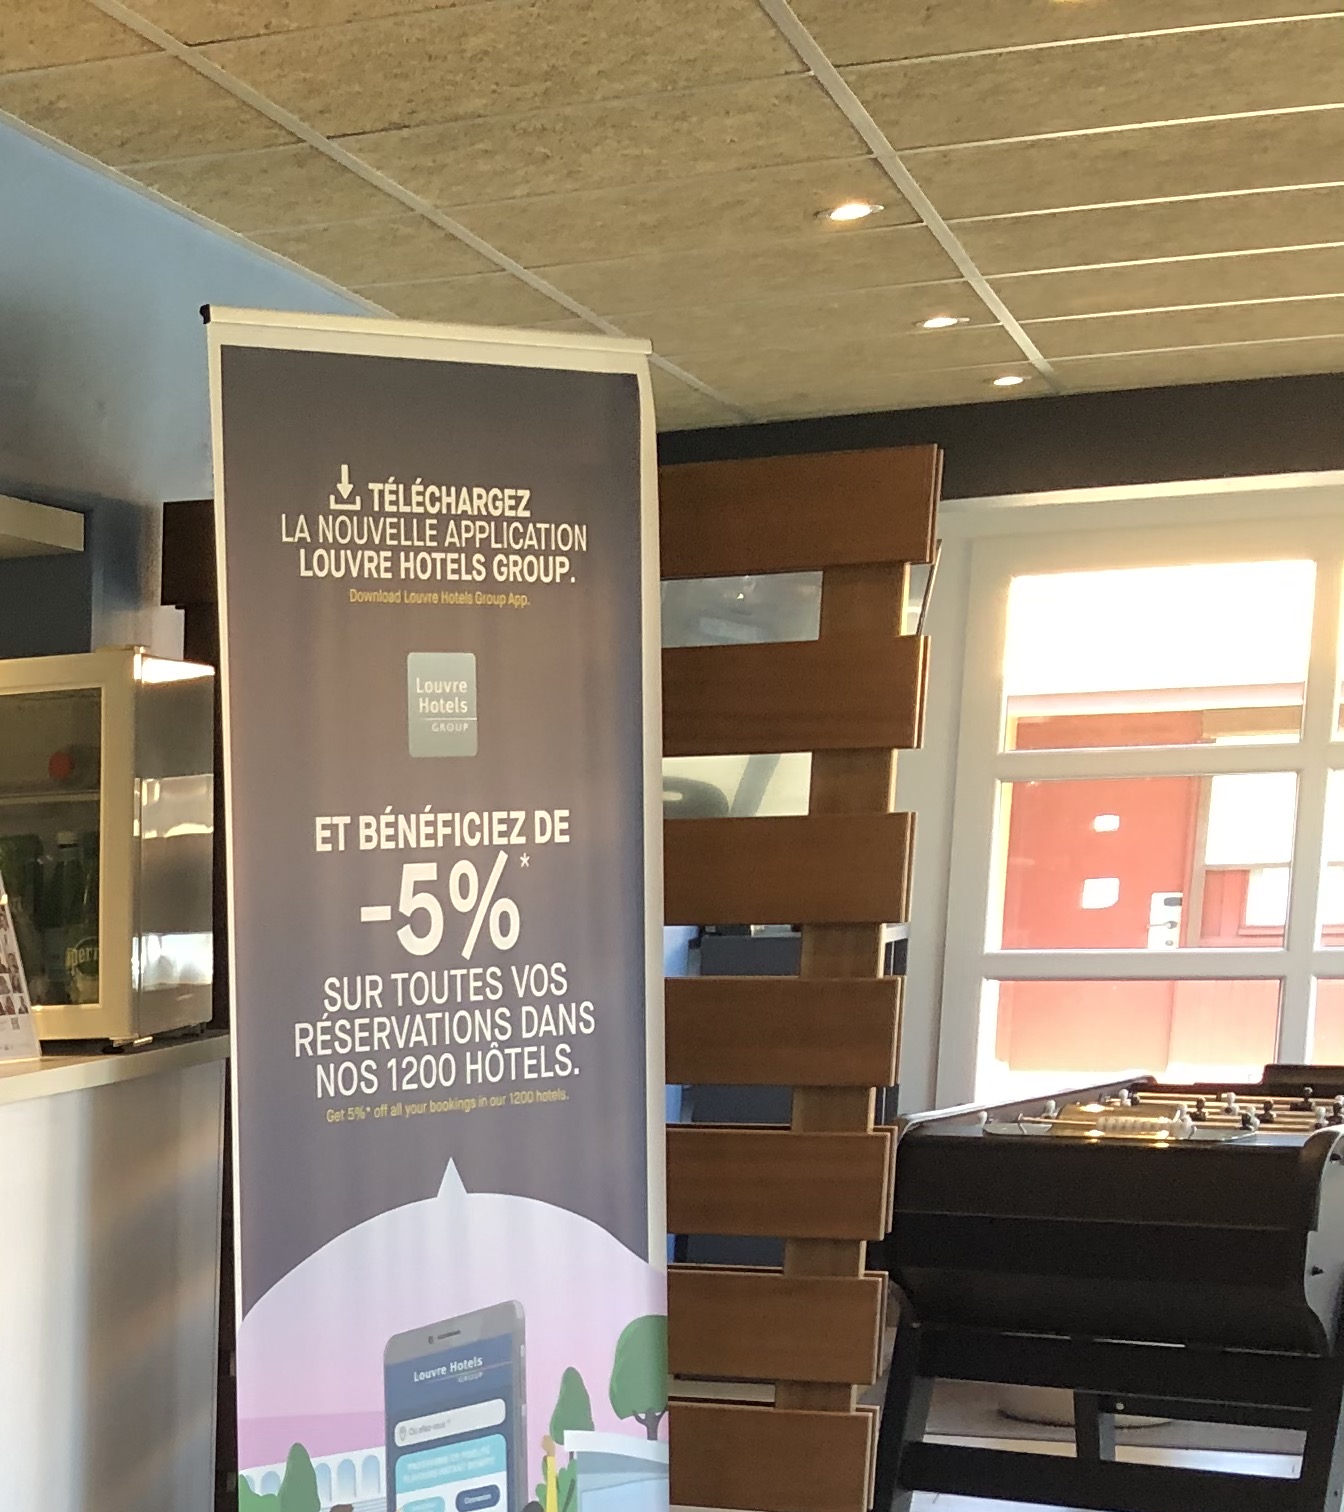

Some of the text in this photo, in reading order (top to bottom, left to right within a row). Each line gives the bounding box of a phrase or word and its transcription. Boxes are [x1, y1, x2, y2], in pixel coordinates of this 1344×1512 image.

[368, 476, 531, 517] TÉLÉCHARGEZ
[281, 514, 587, 552] LA NOUVELLE APPLICATION
[299, 548, 576, 583] LOUVRE HOTELS GROUP.
[349, 589, 531, 608] Download Louvre Hotels Group App.
[416, 677, 468, 694] Louvre
[418, 697, 468, 713] Hotels
[432, 723, 469, 732] GROUP
[315, 805, 571, 852] ET BÉNÉFICIEZ DE
[323, 961, 568, 1013] SUR TOUTES VOS
[294, 1001, 596, 1058] RÉSERVATIONS DANS
[316, 1042, 580, 1099] NOS 1200 HÔTELS.
[326, 1108, 345, 1123] Get
[374, 1104, 388, 1119] off
[390, 1102, 403, 1117] all
[405, 1101, 427, 1119] your
[429, 1097, 476, 1113] bookings
[478, 1096, 488, 1108] in
[490, 1094, 507, 1107] our
[509, 1091, 534, 1105] 1200
[536, 1088, 570, 1102] hotels.
[414, 1356, 483, 1382] Louvre Hotels
